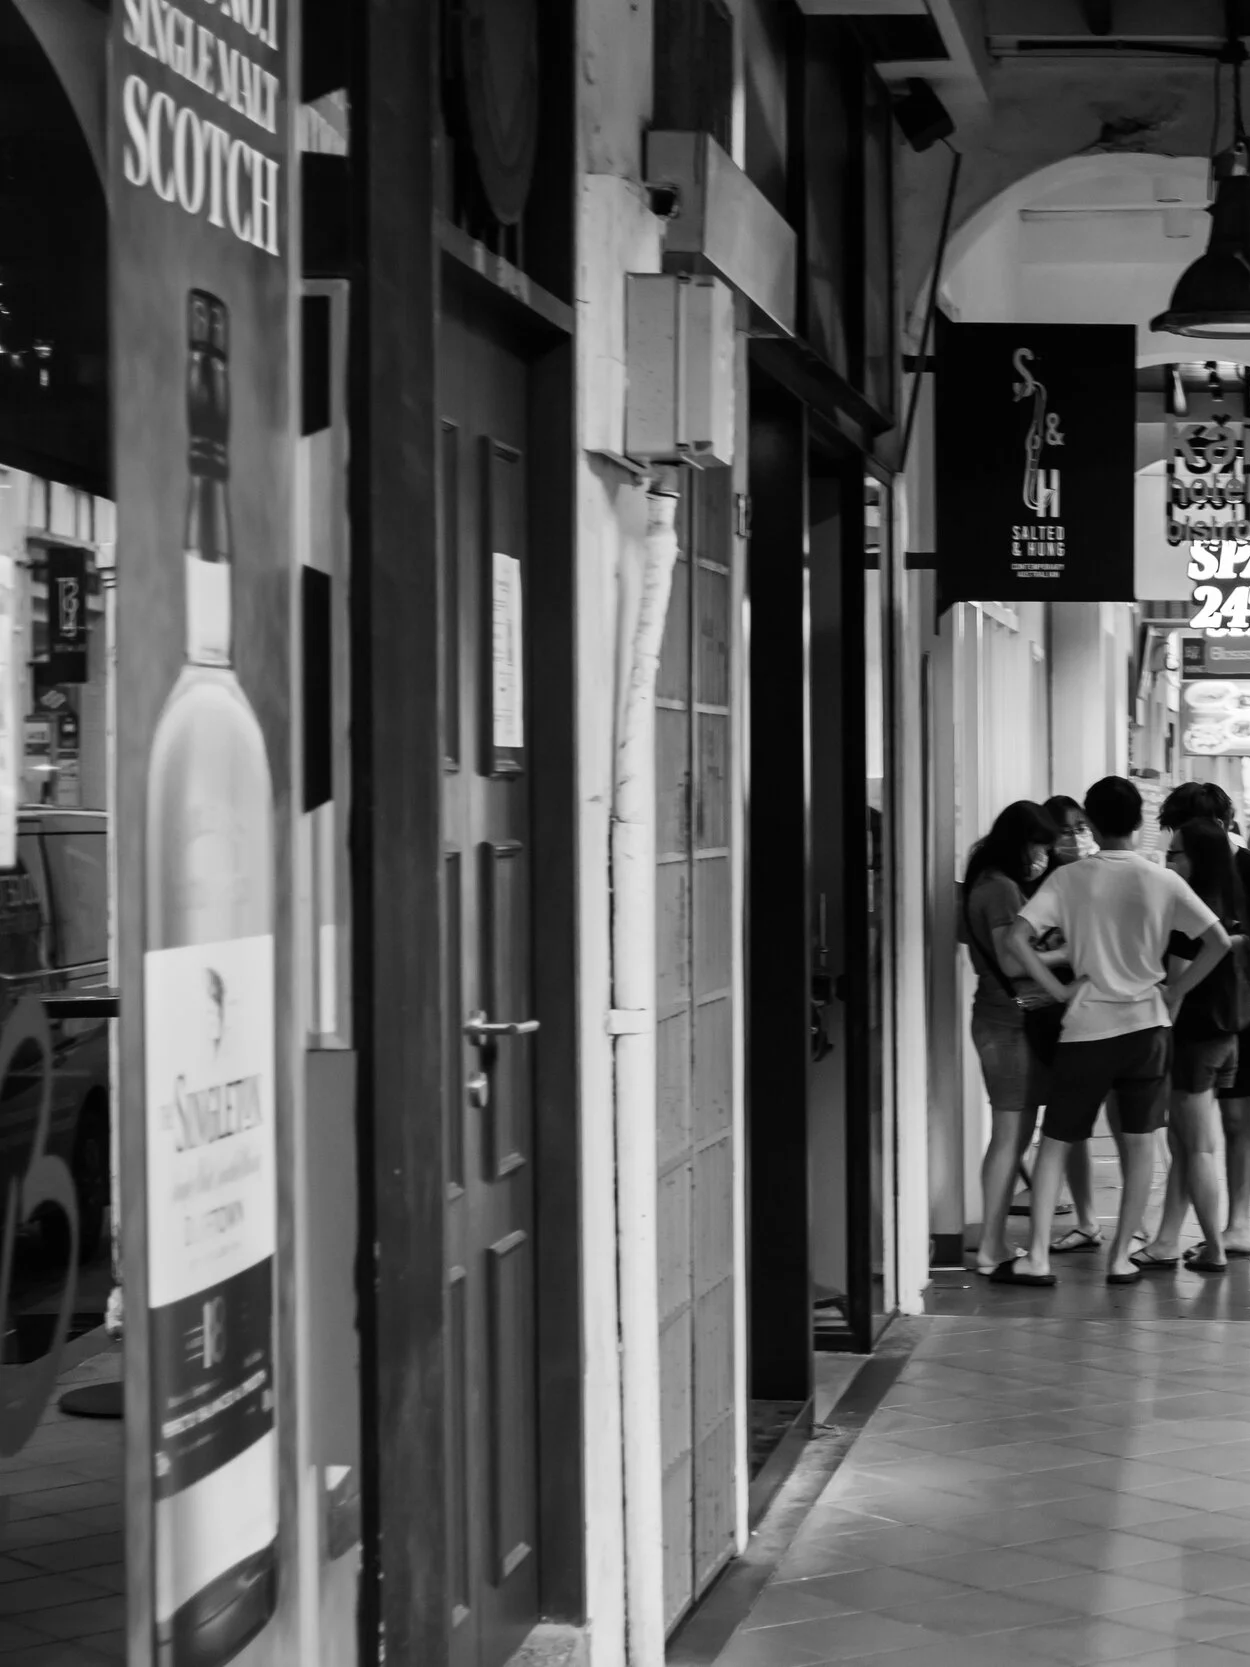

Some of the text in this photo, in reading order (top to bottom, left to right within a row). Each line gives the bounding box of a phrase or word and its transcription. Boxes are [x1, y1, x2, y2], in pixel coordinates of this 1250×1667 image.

[123, 74, 280, 257] SCOTCH
[1012, 525, 1066, 541] SALTED
[1027, 541, 1066, 557] HUNG
